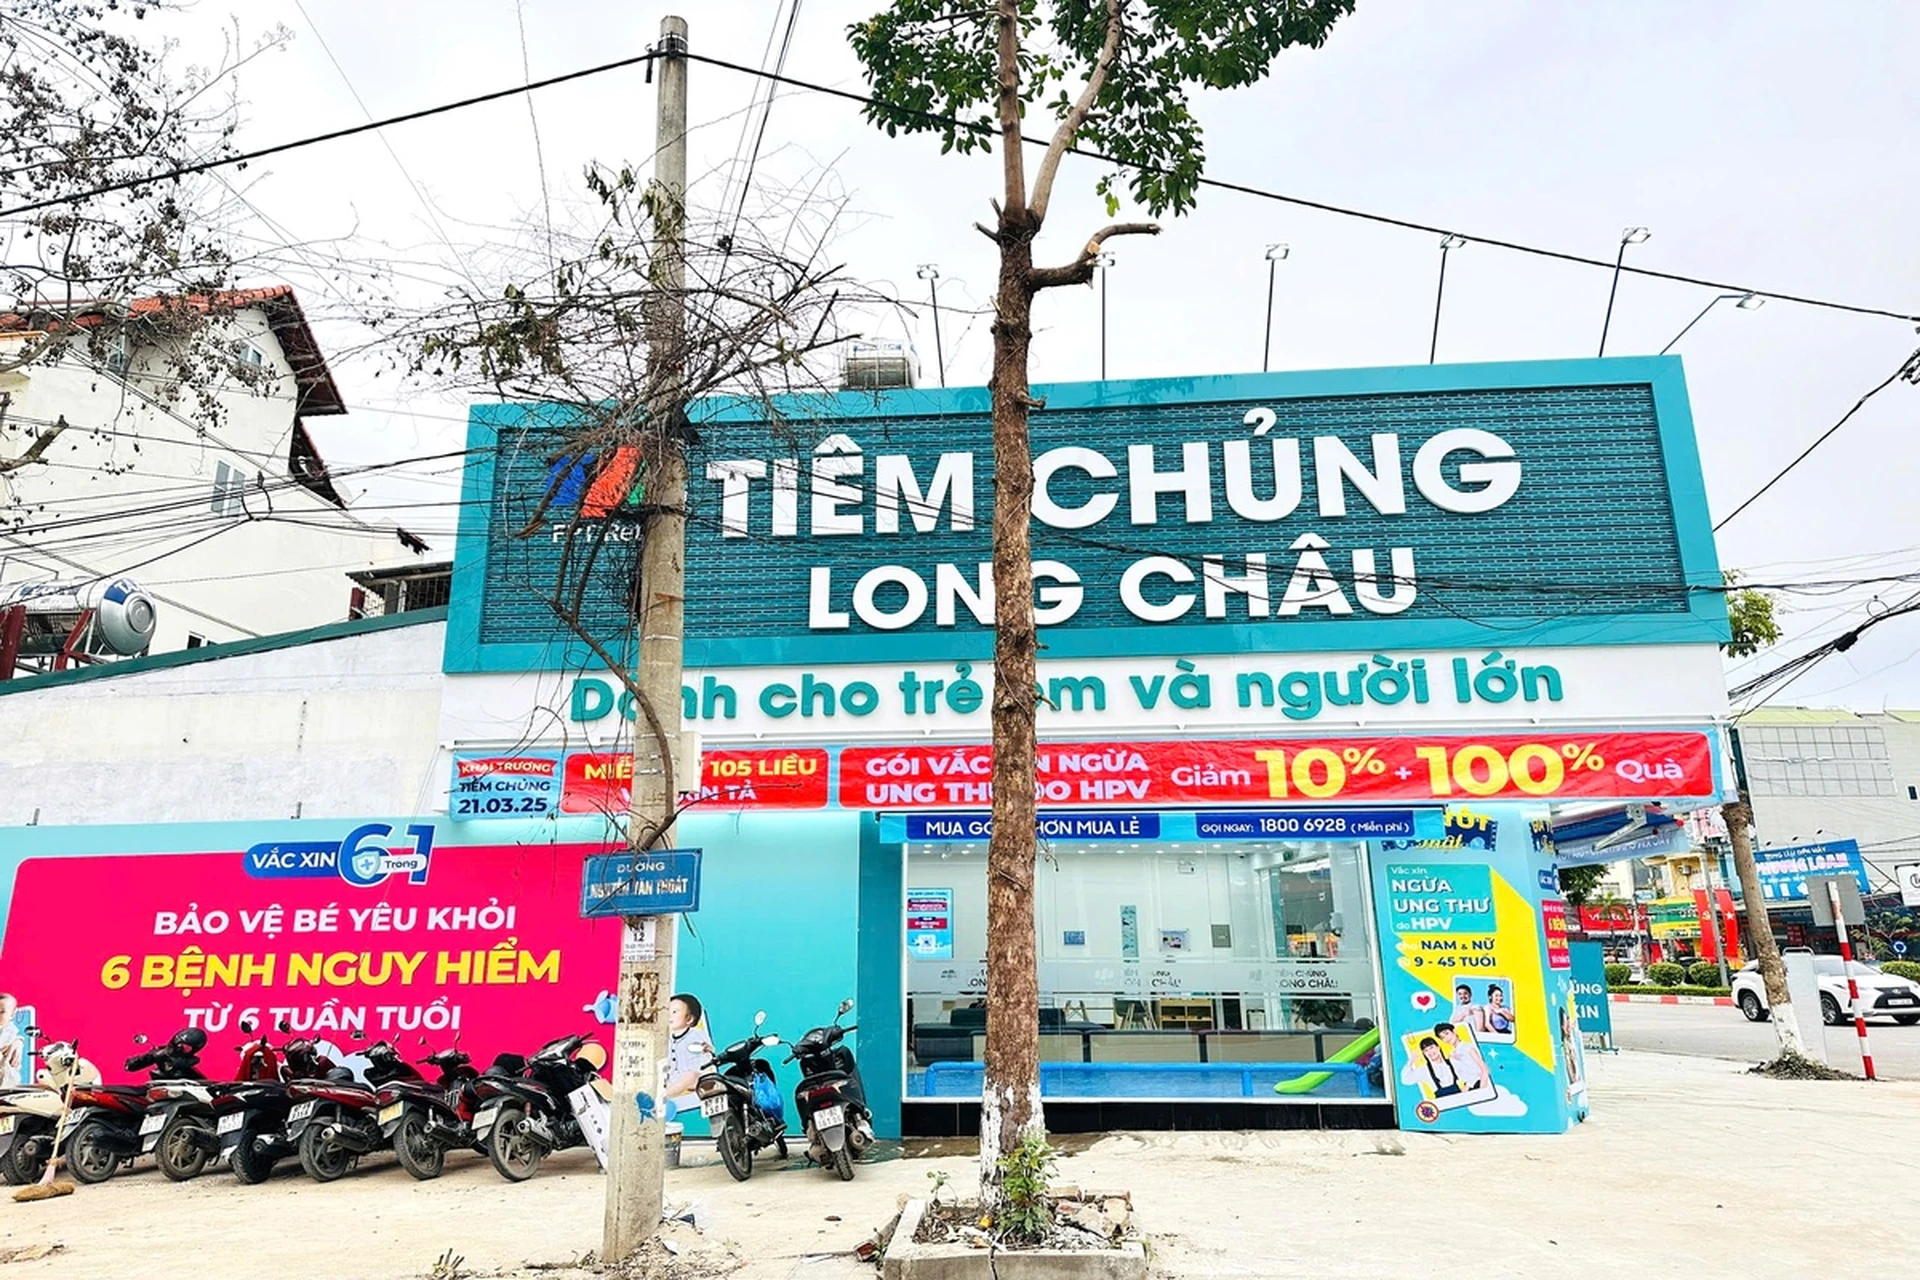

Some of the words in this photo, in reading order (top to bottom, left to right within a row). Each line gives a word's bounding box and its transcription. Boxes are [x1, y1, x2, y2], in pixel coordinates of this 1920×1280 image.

[706, 433, 975, 539] TIÊM
[1029, 407, 1523, 529] CHỦNG
[809, 560, 1084, 629] LONG
[1119, 532, 1417, 622] CHÂU
[759, 674, 880, 721] cho
[898, 661, 984, 715] trẻ
[1129, 658, 1211, 711] và
[1237, 654, 1430, 721] người
[1454, 651, 1564, 705] lớn
[584, 755, 632, 780] MIỄ
[710, 758, 753, 777] 105
[758, 751, 817, 776] LIỀU
[865, 752, 919, 778] GÓI
[923, 748, 991, 776] VẮC
[1058, 750, 1149, 774] NGỪA
[1171, 755, 1251, 788] Giảm
[1255, 744, 1386, 798] 10%
[1416, 743, 1605, 796] 100%
[1616, 757, 1684, 783] Quà
[495, 778, 551, 792] CHỦNG
[865, 781, 937, 804] UNG
[944, 780, 993, 803] TH
[1081, 778, 1152, 801] HPV
[458, 797, 548, 814] 21.03.25
[926, 819, 965, 836] MUA
[1077, 818, 1114, 835] MUA
[1117, 815, 1140, 835] LẺ
[1259, 818, 1301, 833] 1800
[1303, 817, 1346, 833] 6928
[251, 846, 296, 869] VẮC
[298, 851, 336, 869] XIN
[385, 859, 418, 870] Trong
[1411, 866, 1427, 875] xin
[1391, 875, 1452, 893] NGỪA
[1394, 899, 1440, 913] UNG
[1444, 897, 1491, 913] THƯ
[153, 903, 230, 936] BẢO
[239, 903, 282, 940] VỆ
[293, 902, 338, 933] BÉ
[348, 902, 417, 932] YÊU
[427, 898, 516, 931] KHỎI
[1396, 920, 1410, 930] do
[1410, 917, 1452, 931] HPV
[1421, 940, 1457, 950] NAM
[1472, 937, 1495, 950] NỮ
[101, 955, 132, 989] 6
[140, 947, 275, 997] BỆNH
[287, 950, 423, 987] NGUY
[435, 937, 561, 985] HIỂM
[1414, 956, 1424, 967] 9
[1438, 956, 1456, 967] 45
[1459, 952, 1497, 967] TUỔI
[183, 1000, 231, 1033] TỪ
[238, 1006, 259, 1032] 6
[270, 997, 365, 1031] TUẦN
[375, 995, 461, 1030] TUỔI
